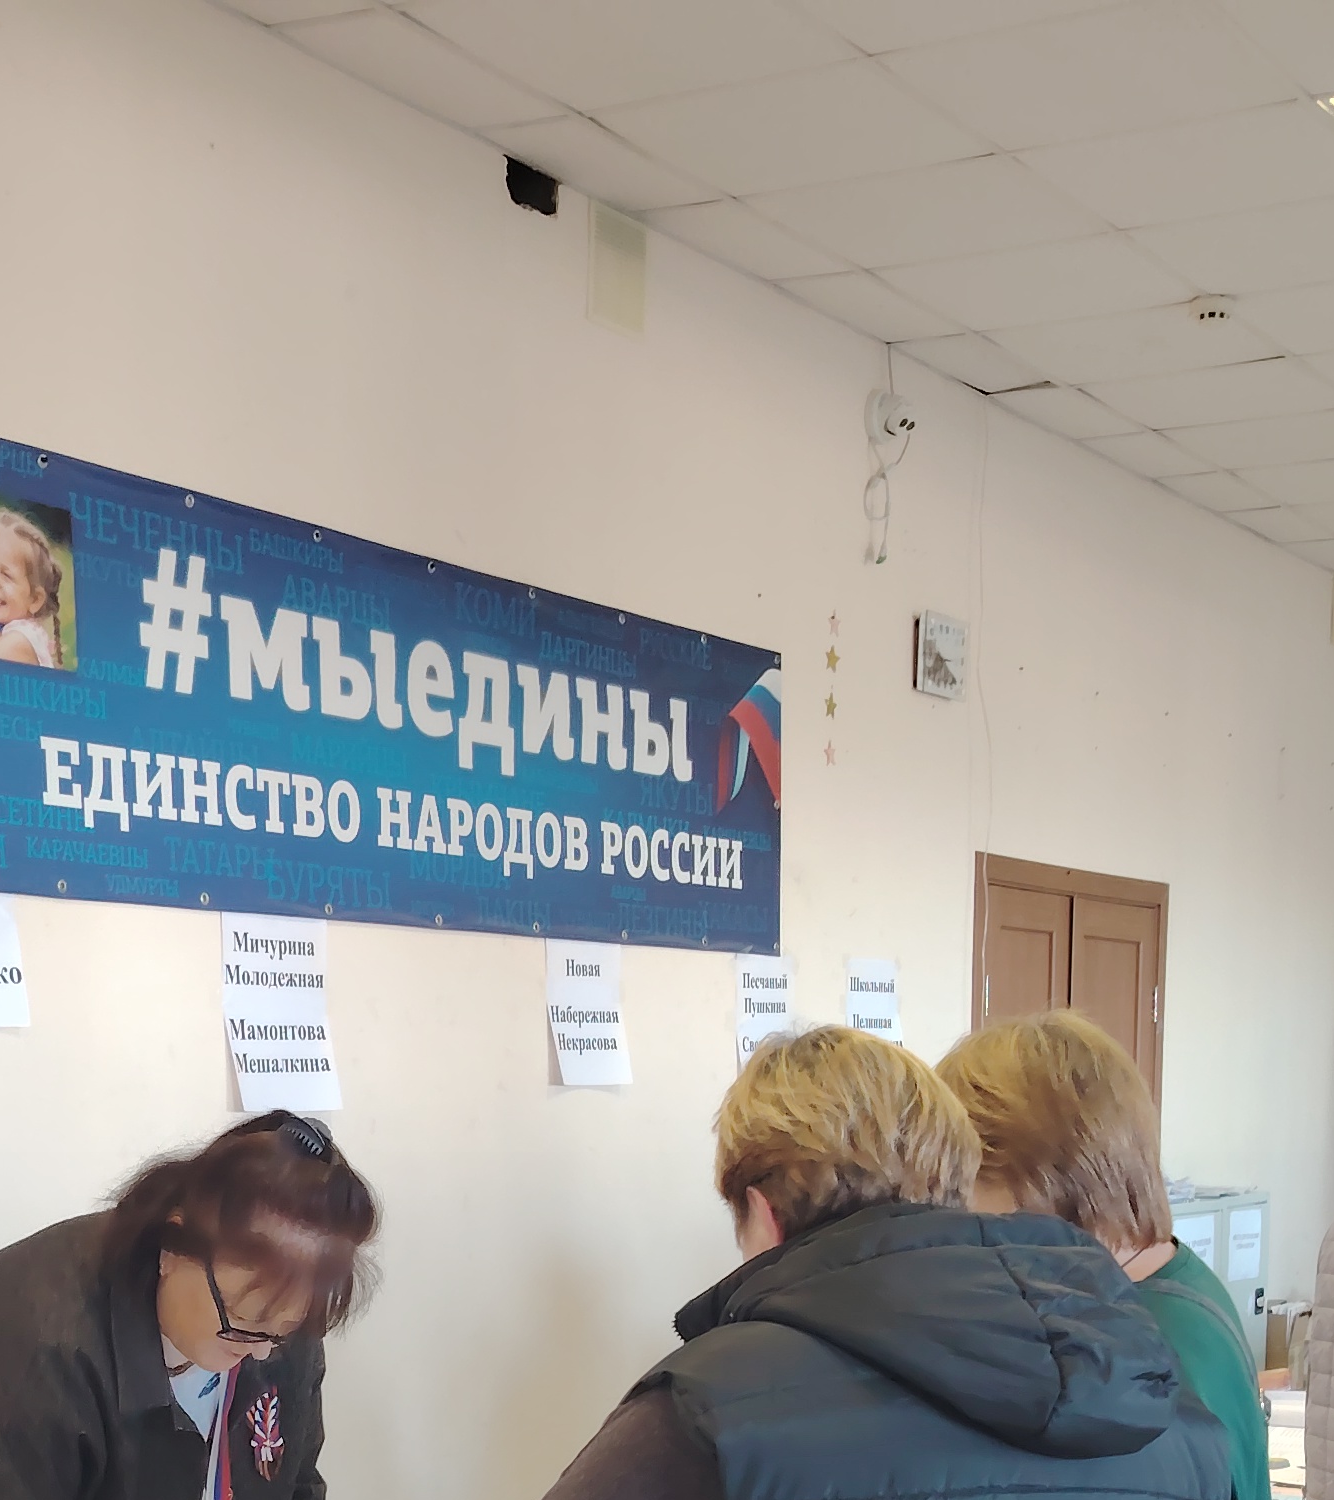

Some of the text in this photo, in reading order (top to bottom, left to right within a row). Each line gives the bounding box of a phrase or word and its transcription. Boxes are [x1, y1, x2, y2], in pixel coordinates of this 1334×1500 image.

[68, 491, 244, 576] ЧЕЧЕНЦЫ
[248, 527, 344, 575] БАШКИРЫ
[281, 573, 392, 632] АВАРЦЫ
[539, 630, 637, 680] ДАРГИНЦЫ
[40, 736, 743, 890] ЕДИНСТВО НАРОДОВ РОССИИ
[25, 834, 149, 871] КАРАЧАЕВЦЫ
[164, 835, 276, 881] ТАТАРЫ
[267, 857, 393, 911] БУРЯТЫ
[232, 931, 315, 960] Мичурина
[224, 963, 324, 989] Молодежная
[565, 958, 601, 977] Новая
[742, 972, 788, 990] Песчаный
[849, 976, 895, 994] Школьный
[550, 1005, 620, 1028] Набережная
[744, 998, 787, 1018] Пушкина
[229, 1018, 327, 1041] Мамонтова
[557, 1033, 618, 1055] Некрасова
[234, 1052, 331, 1074] Мешалкина
